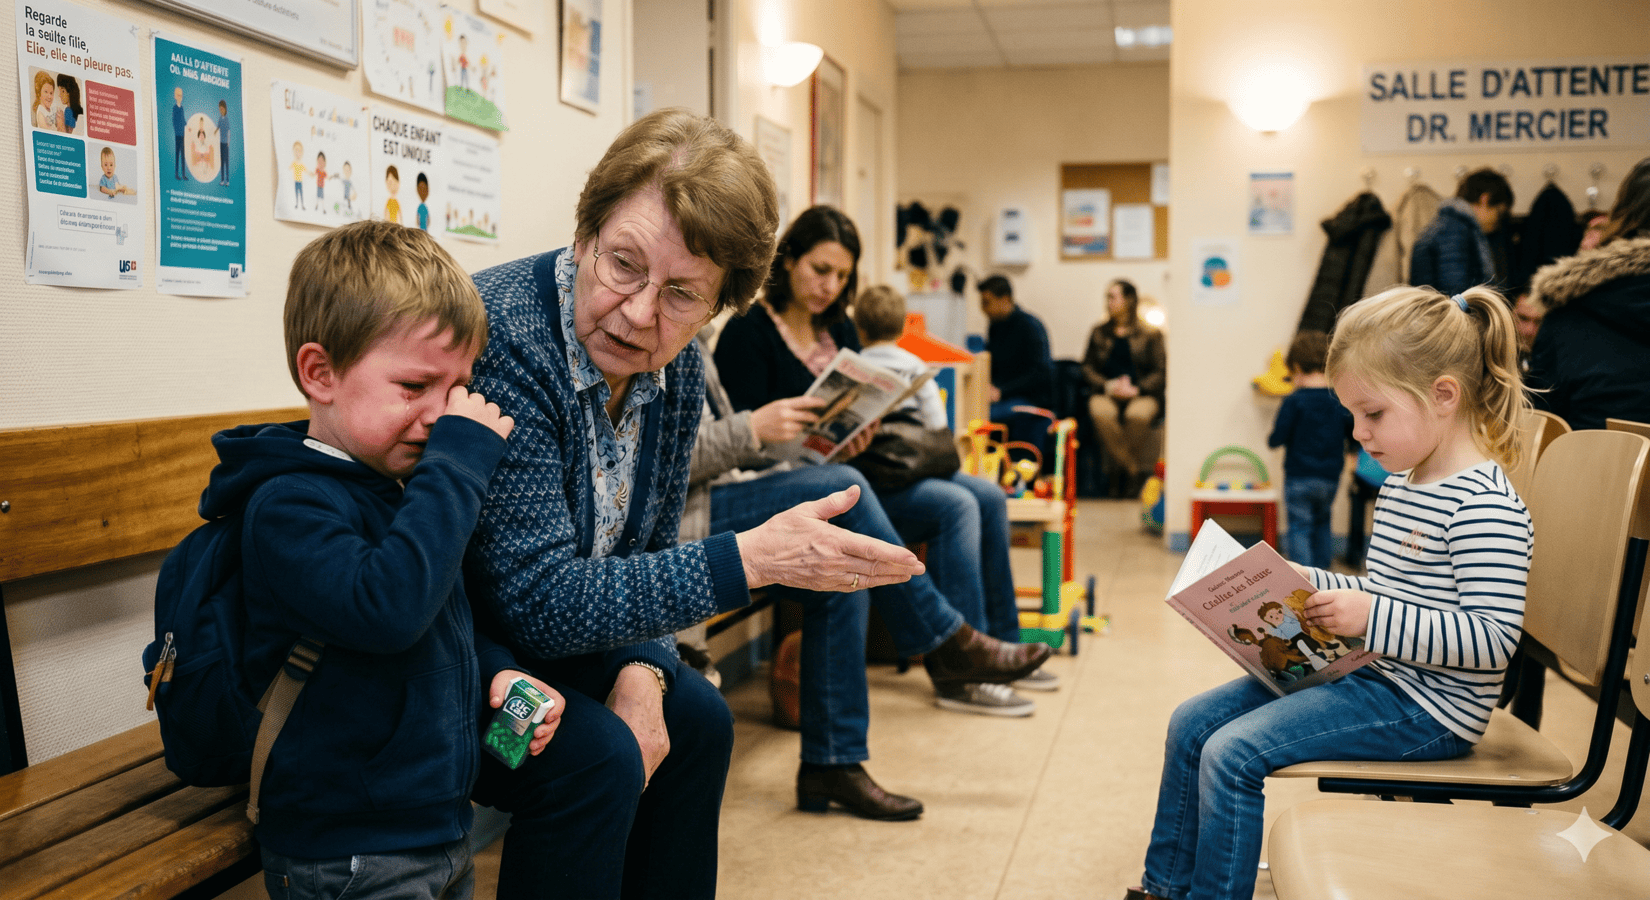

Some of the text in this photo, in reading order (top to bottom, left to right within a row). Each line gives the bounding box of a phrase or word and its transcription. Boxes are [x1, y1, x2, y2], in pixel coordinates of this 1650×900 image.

[25, 5, 67, 28] Regarde
[25, 22, 35, 37] la
[70, 54, 82, 66] ne
[84, 56, 113, 73] pleure
[1370, 63, 1650, 101] SALLE D'ATTENTE
[373, 115, 442, 146] CHAQUE ENFANT
[1407, 108, 1609, 142] DR. MERCIER
[383, 139, 399, 155] EST
[401, 144, 432, 165] UNIQUE
[509, 702, 527, 719] tac
[516, 699, 531, 714] tic
